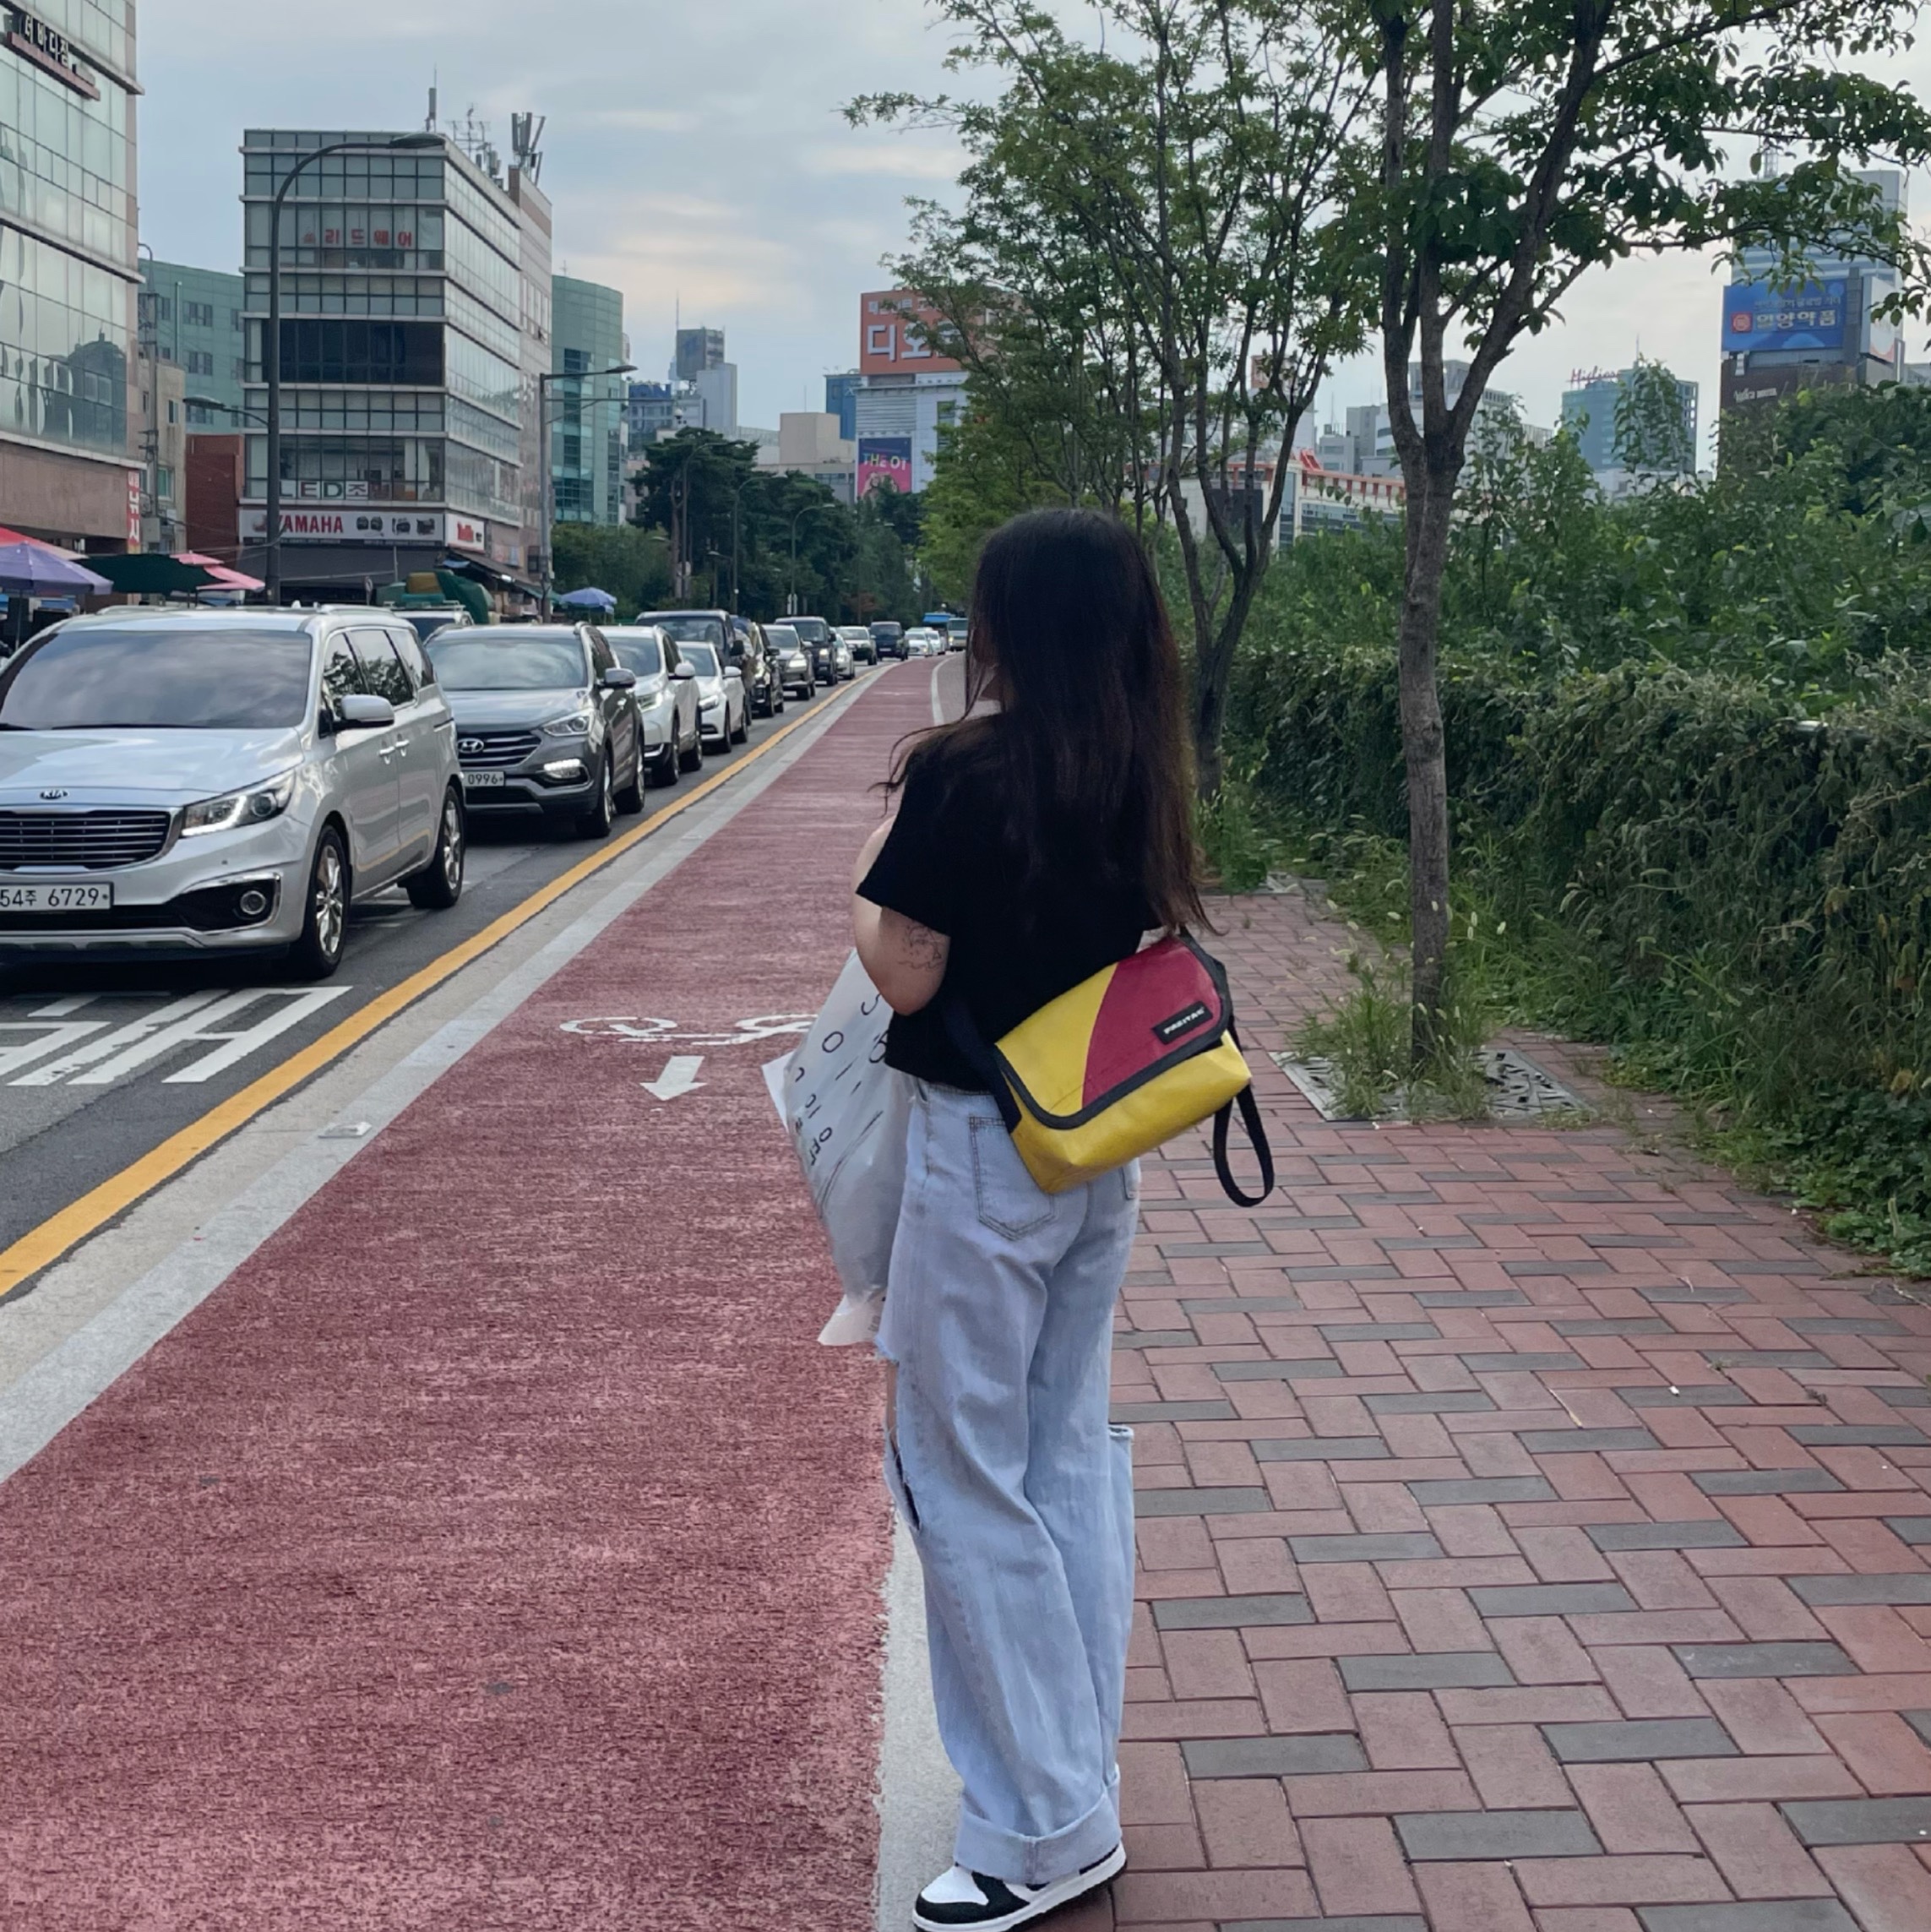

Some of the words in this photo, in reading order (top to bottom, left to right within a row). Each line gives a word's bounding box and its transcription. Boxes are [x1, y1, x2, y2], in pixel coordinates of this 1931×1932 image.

[280, 514, 344, 533] AMAHA
[467, 774, 498, 785] 0996
[0, 889, 36, 907] 54주
[47, 887, 100, 907] 6729
